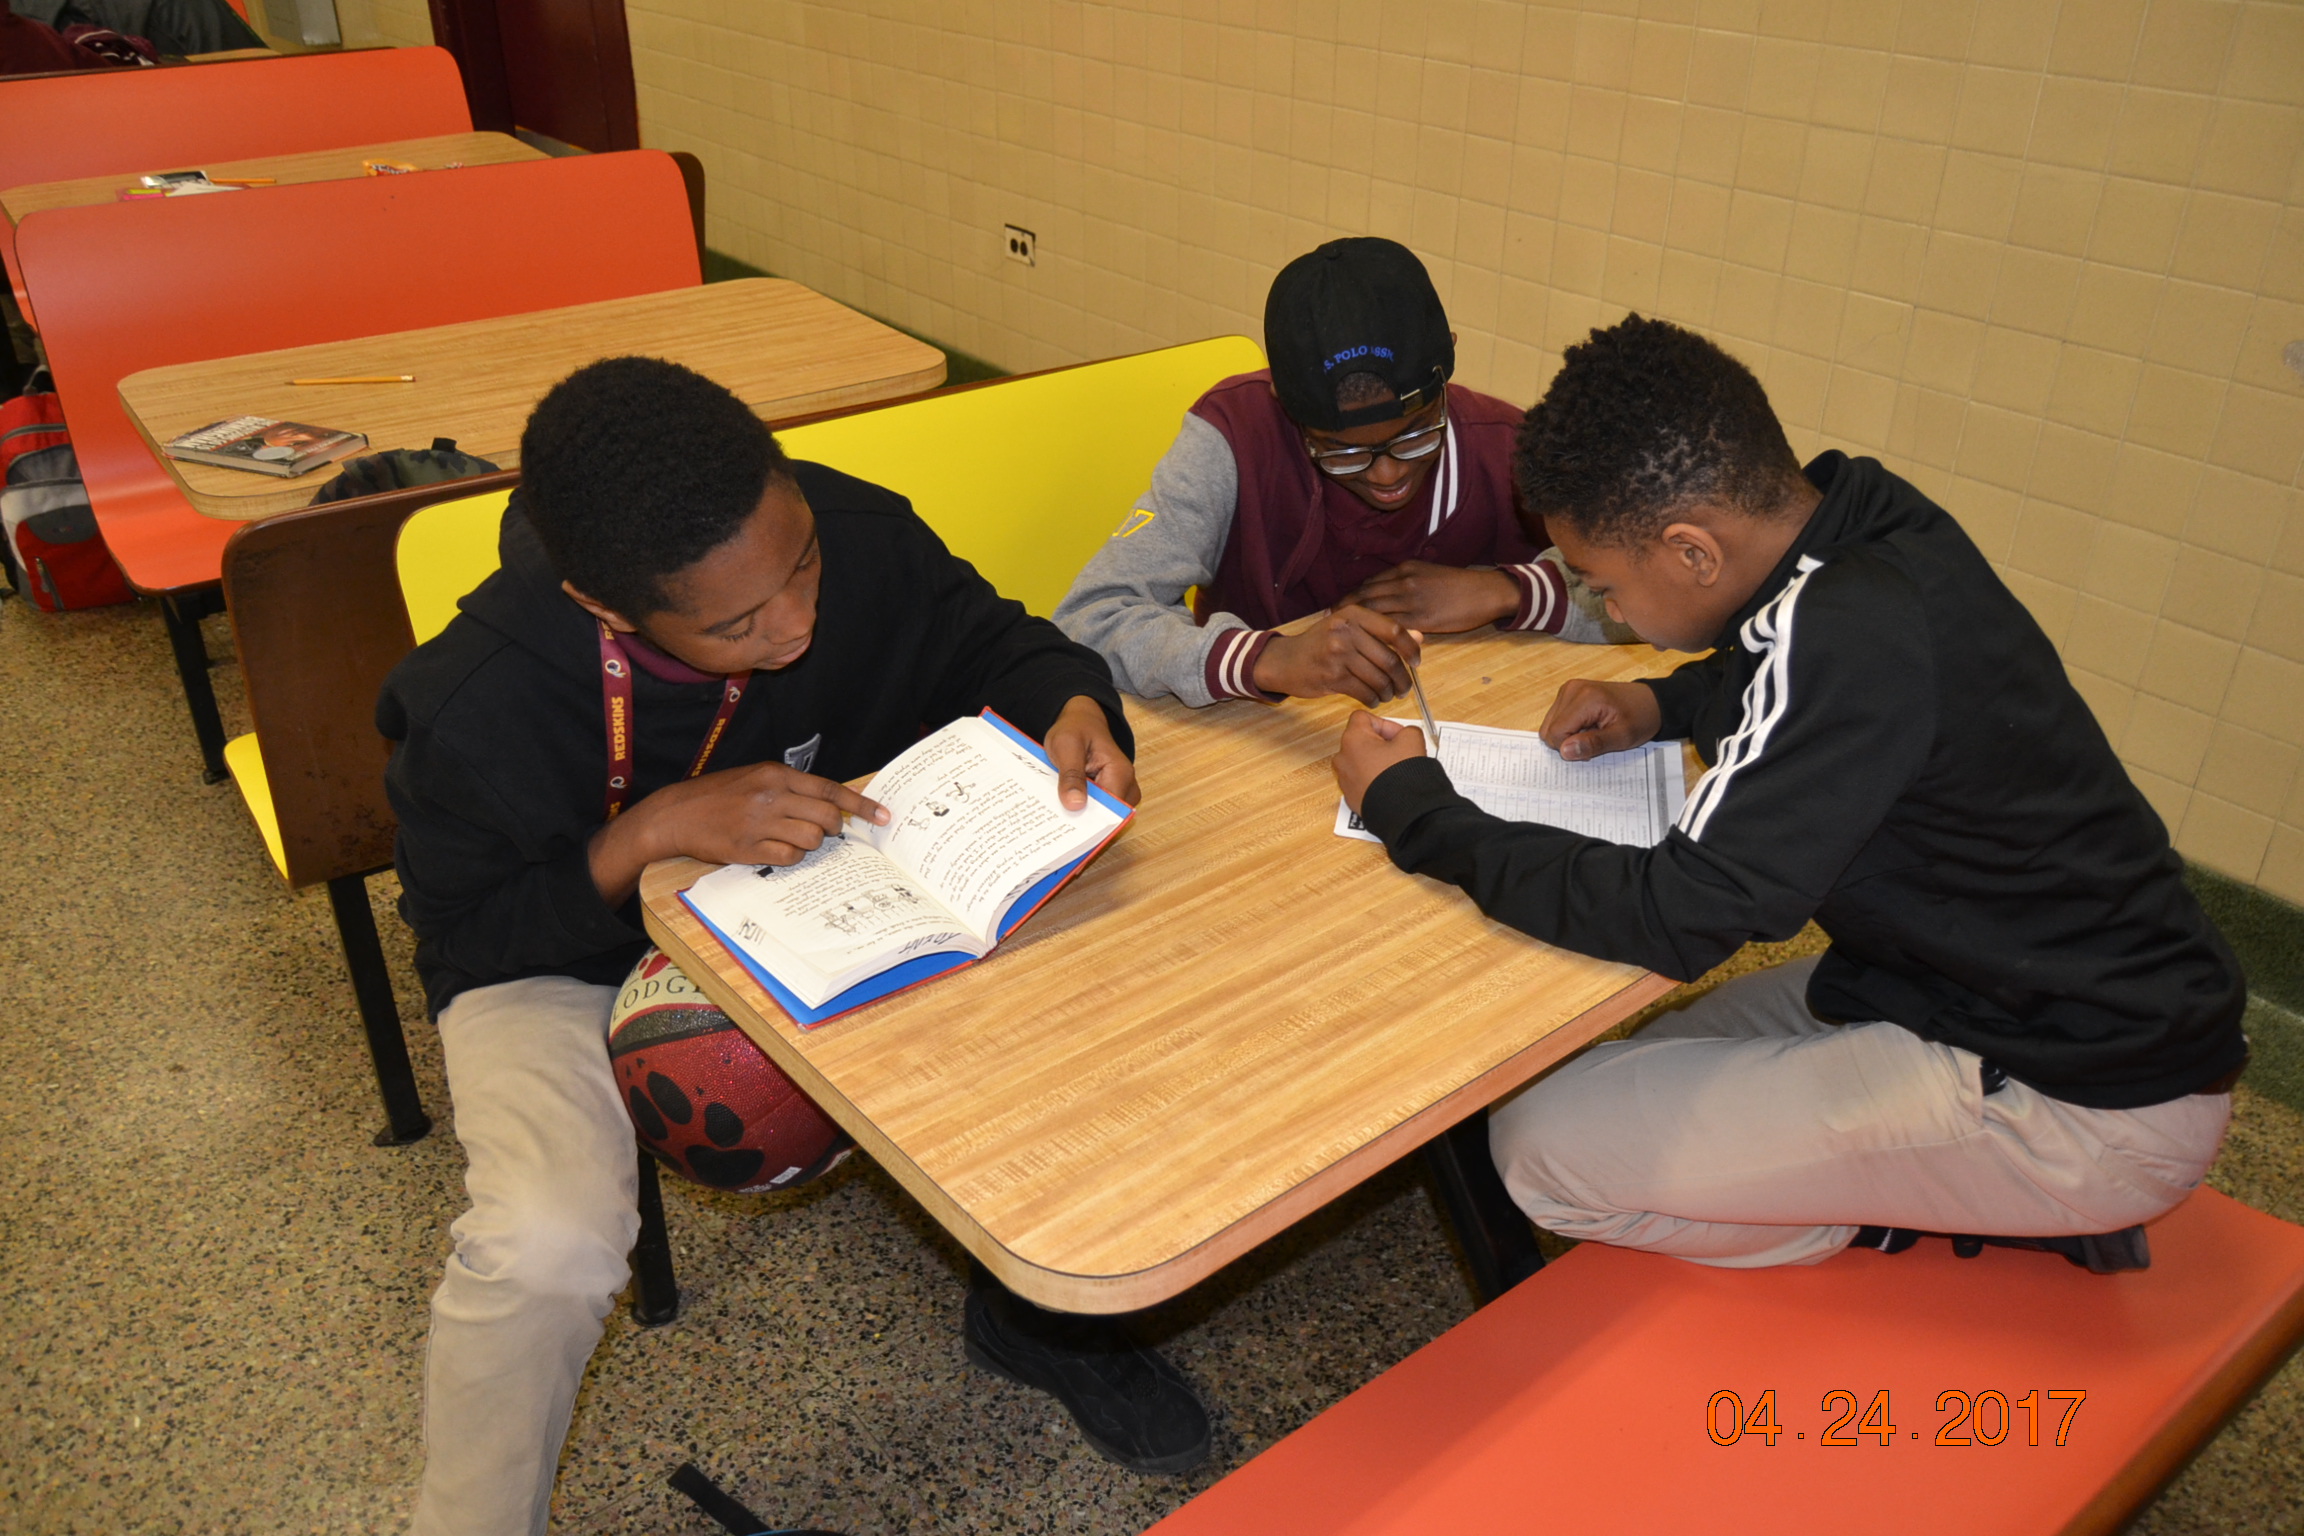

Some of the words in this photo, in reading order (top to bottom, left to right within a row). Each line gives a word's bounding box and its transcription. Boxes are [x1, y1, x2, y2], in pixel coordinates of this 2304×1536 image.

[1334, 345, 1368, 363] POLO
[611, 696, 625, 761] REDSKINS
[691, 718, 726, 777] REDSKINS
